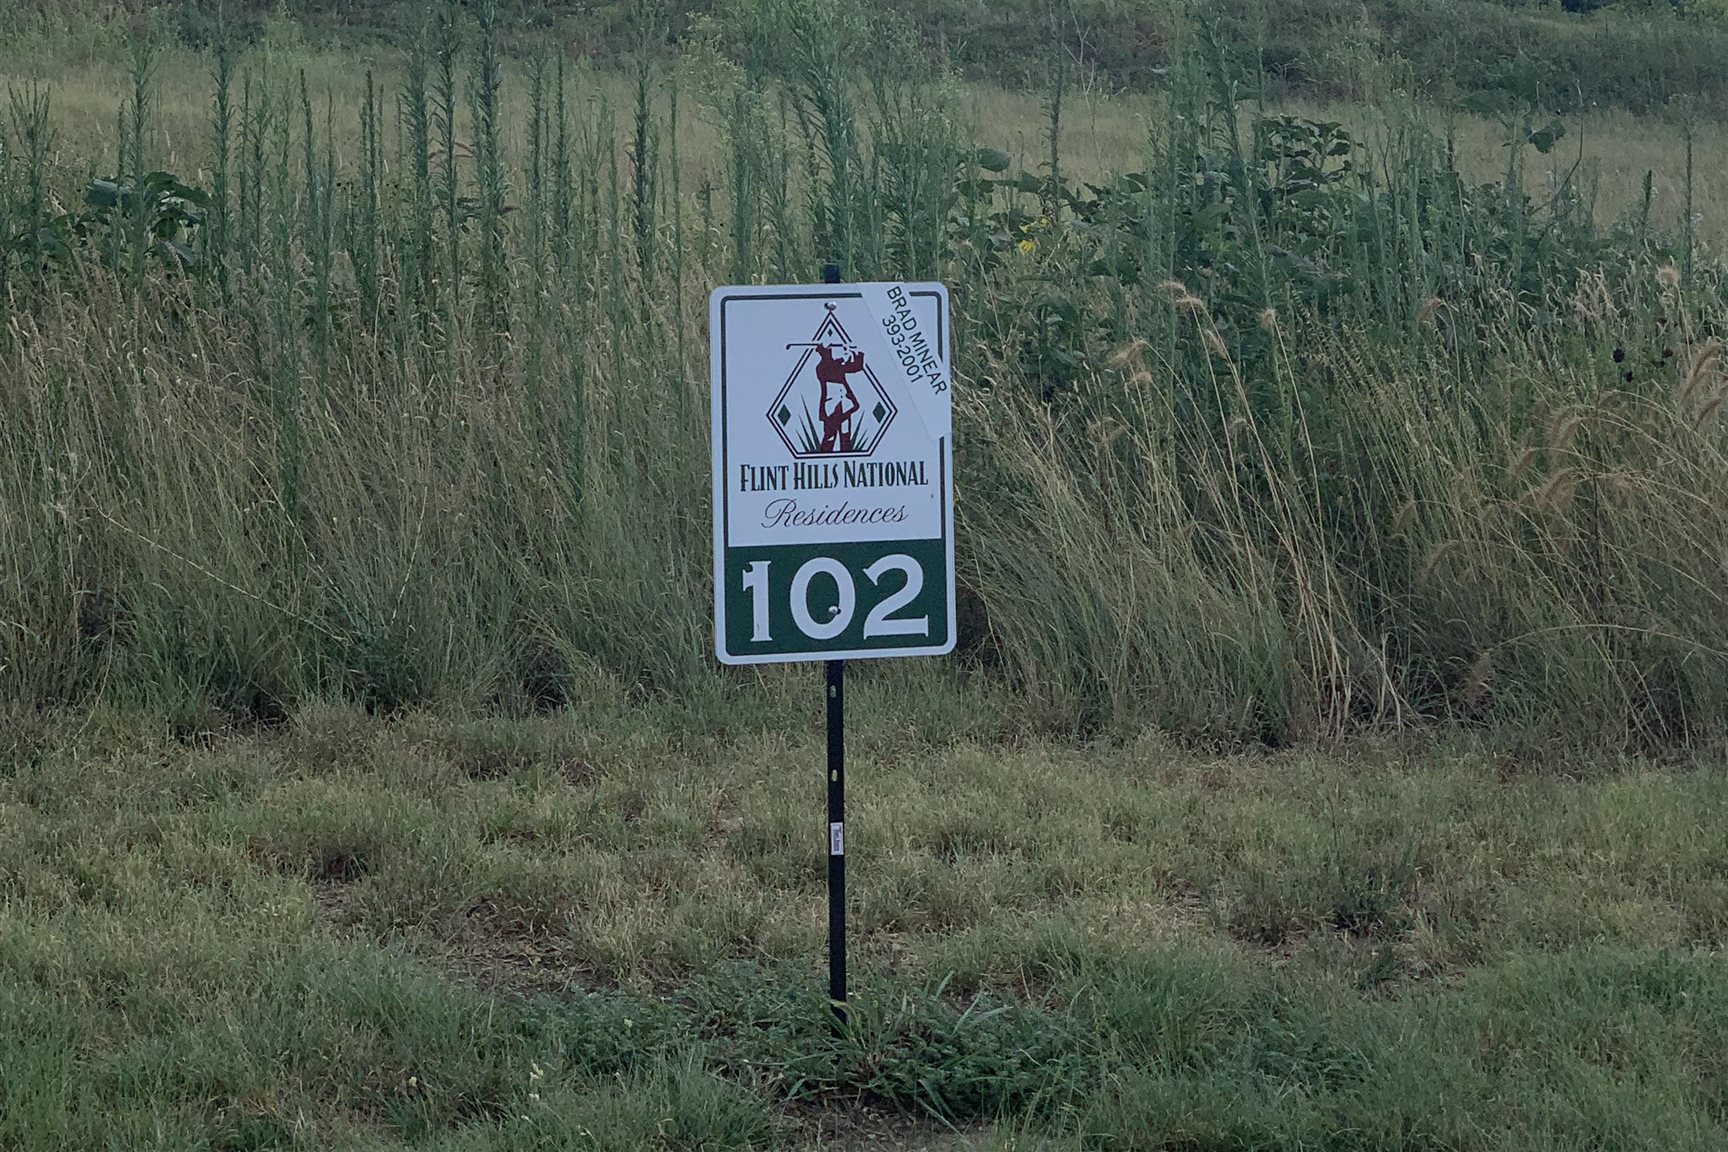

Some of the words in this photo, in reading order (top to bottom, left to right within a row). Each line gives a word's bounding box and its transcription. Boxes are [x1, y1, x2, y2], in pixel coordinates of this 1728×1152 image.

[882, 315, 923, 383] 393-2001
[887, 286, 917, 330] BRAD
[909, 330, 947, 394] MINEAR
[740, 464, 789, 492] FLINT
[793, 461, 839, 490] HILLS
[843, 460, 929, 488] NATIONAL
[761, 498, 908, 529] Residences
[742, 554, 929, 642] 102
